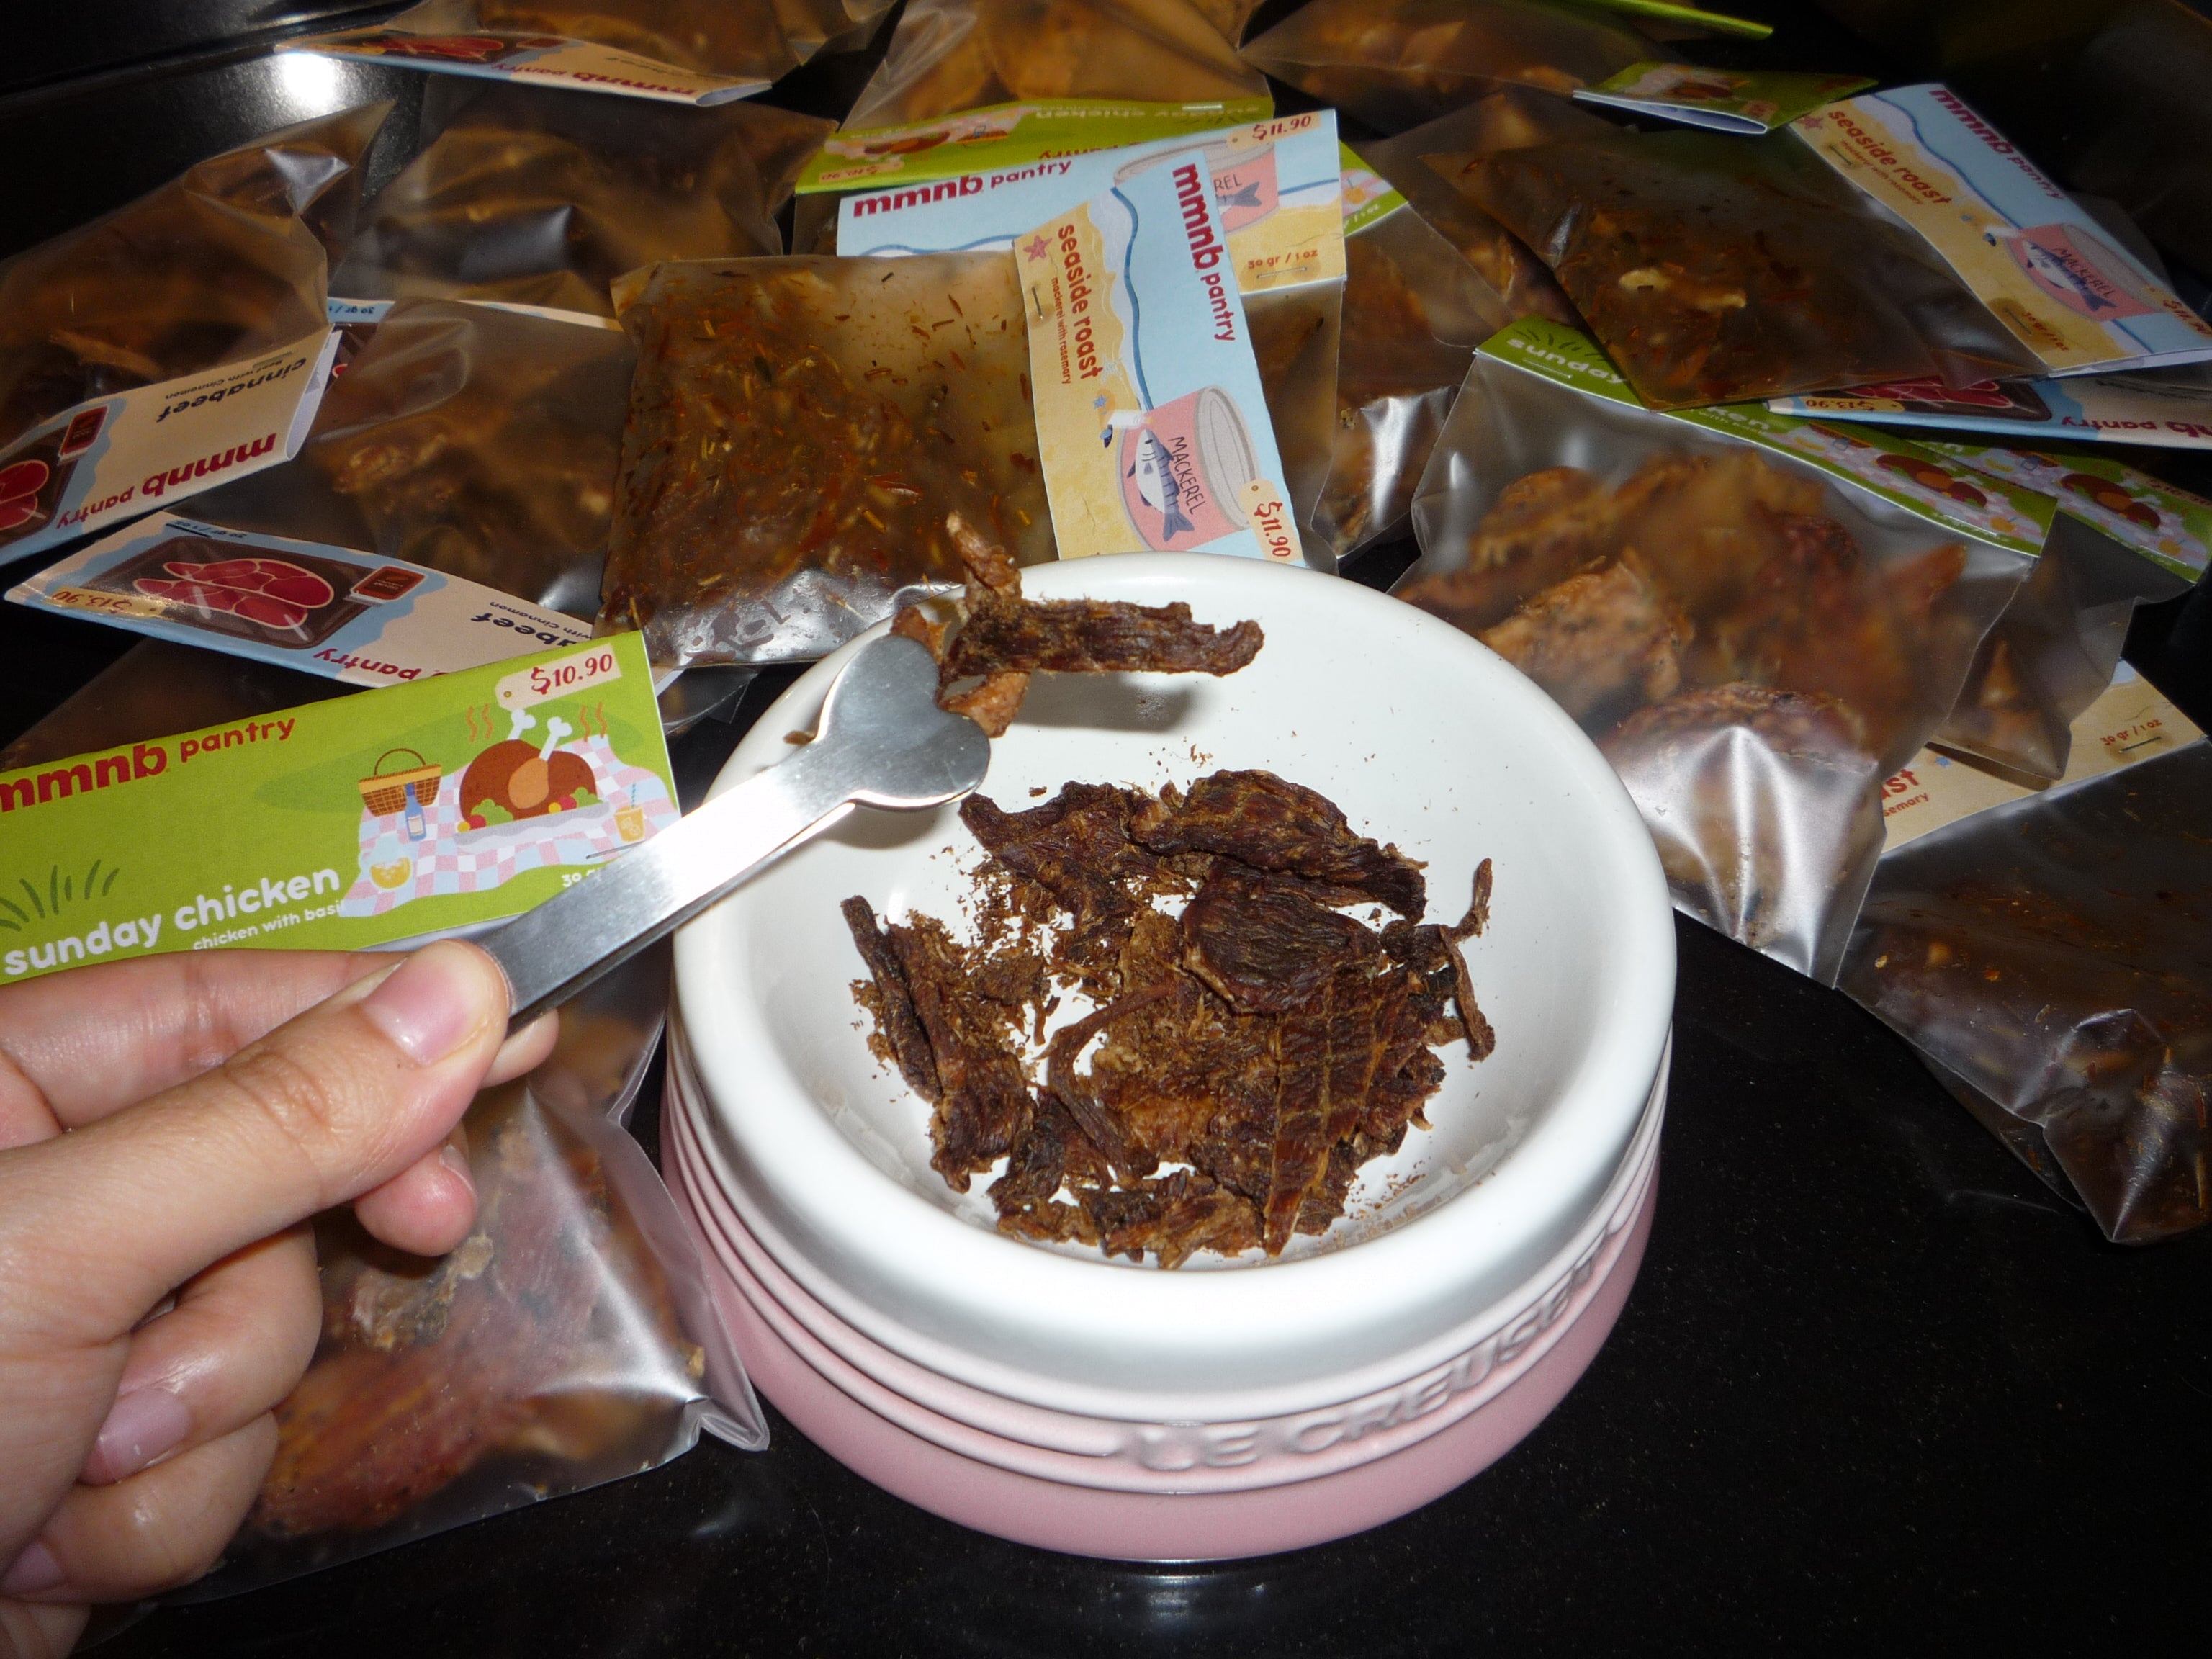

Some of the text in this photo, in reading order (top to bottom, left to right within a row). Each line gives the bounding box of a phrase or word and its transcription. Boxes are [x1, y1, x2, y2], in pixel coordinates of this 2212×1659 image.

[1251, 115, 1312, 140] $11.90
[1929, 89, 2064, 200] mmnb pantry
[1827, 110, 1953, 205] seaside roast
[853, 160, 1072, 218] mmnb pantry
[1172, 163, 1236, 341] mmnb pantry
[1267, 253, 1280, 267] gr
[1303, 248, 1318, 258] oz
[2054, 248, 2115, 297] MACKEREL
[1058, 224, 1103, 379] seaside roast
[1051, 276, 1071, 385] mackerel with rosemary
[1506, 338, 1627, 385] sunday
[156, 356, 307, 423] cinnabeef
[165, 378, 226, 400] Cinnamon
[2062, 414, 2157, 431] pantry
[57, 433, 277, 529] mmnb pantry
[1167, 436, 1206, 516] MACKEREL
[1253, 500, 1291, 558] $11.90
[53, 591, 133, 616] $13.90
[490, 601, 560, 630] Cinnamon
[313, 647, 422, 680] pantry
[530, 653, 613, 696] $10.90
[179, 718, 296, 763] pantry
[2100, 735, 2116, 746] 30
[2116, 730, 2129, 741] gr
[2146, 719, 2162, 728] oz
[4, 868, 340, 976] sunday chicken
[192, 925, 258, 950] chicken
[262, 912, 301, 932] with
